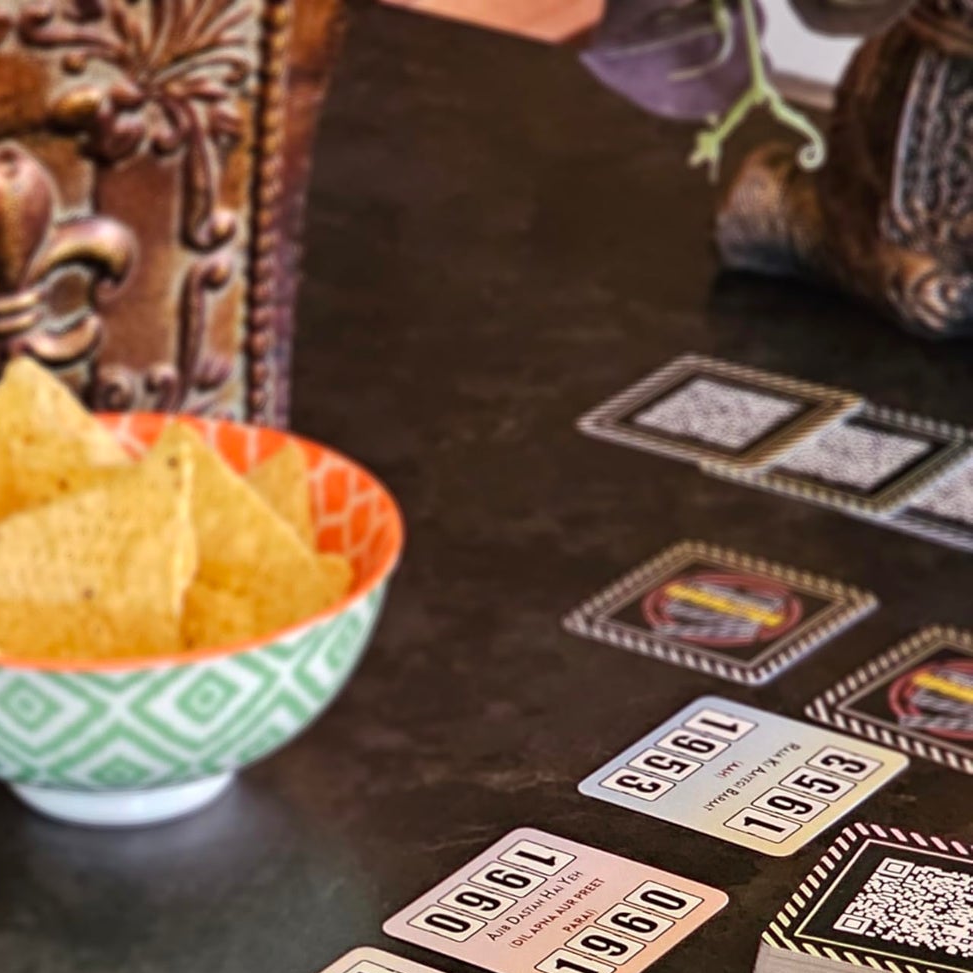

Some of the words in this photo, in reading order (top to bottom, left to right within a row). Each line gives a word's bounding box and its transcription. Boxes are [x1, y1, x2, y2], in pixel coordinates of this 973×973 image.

[614, 716, 740, 795] 1953
[733, 765, 767, 789] AAYEGI
[773, 742, 802, 758] RAJA
[703, 787, 740, 812] BARAAT
[742, 753, 868, 834] 1953
[423, 849, 557, 934] 1960
[486, 924, 511, 942] AJIB
[506, 899, 546, 926] DASTAN
[539, 885, 564, 900] HAI
[558, 870, 584, 886] YEH
[508, 931, 533, 949] (DIL
[530, 914, 558, 935] APNA
[555, 899, 579, 916] AUR
[573, 877, 606, 900] PREET
[562, 908, 600, 933] PARAI)
